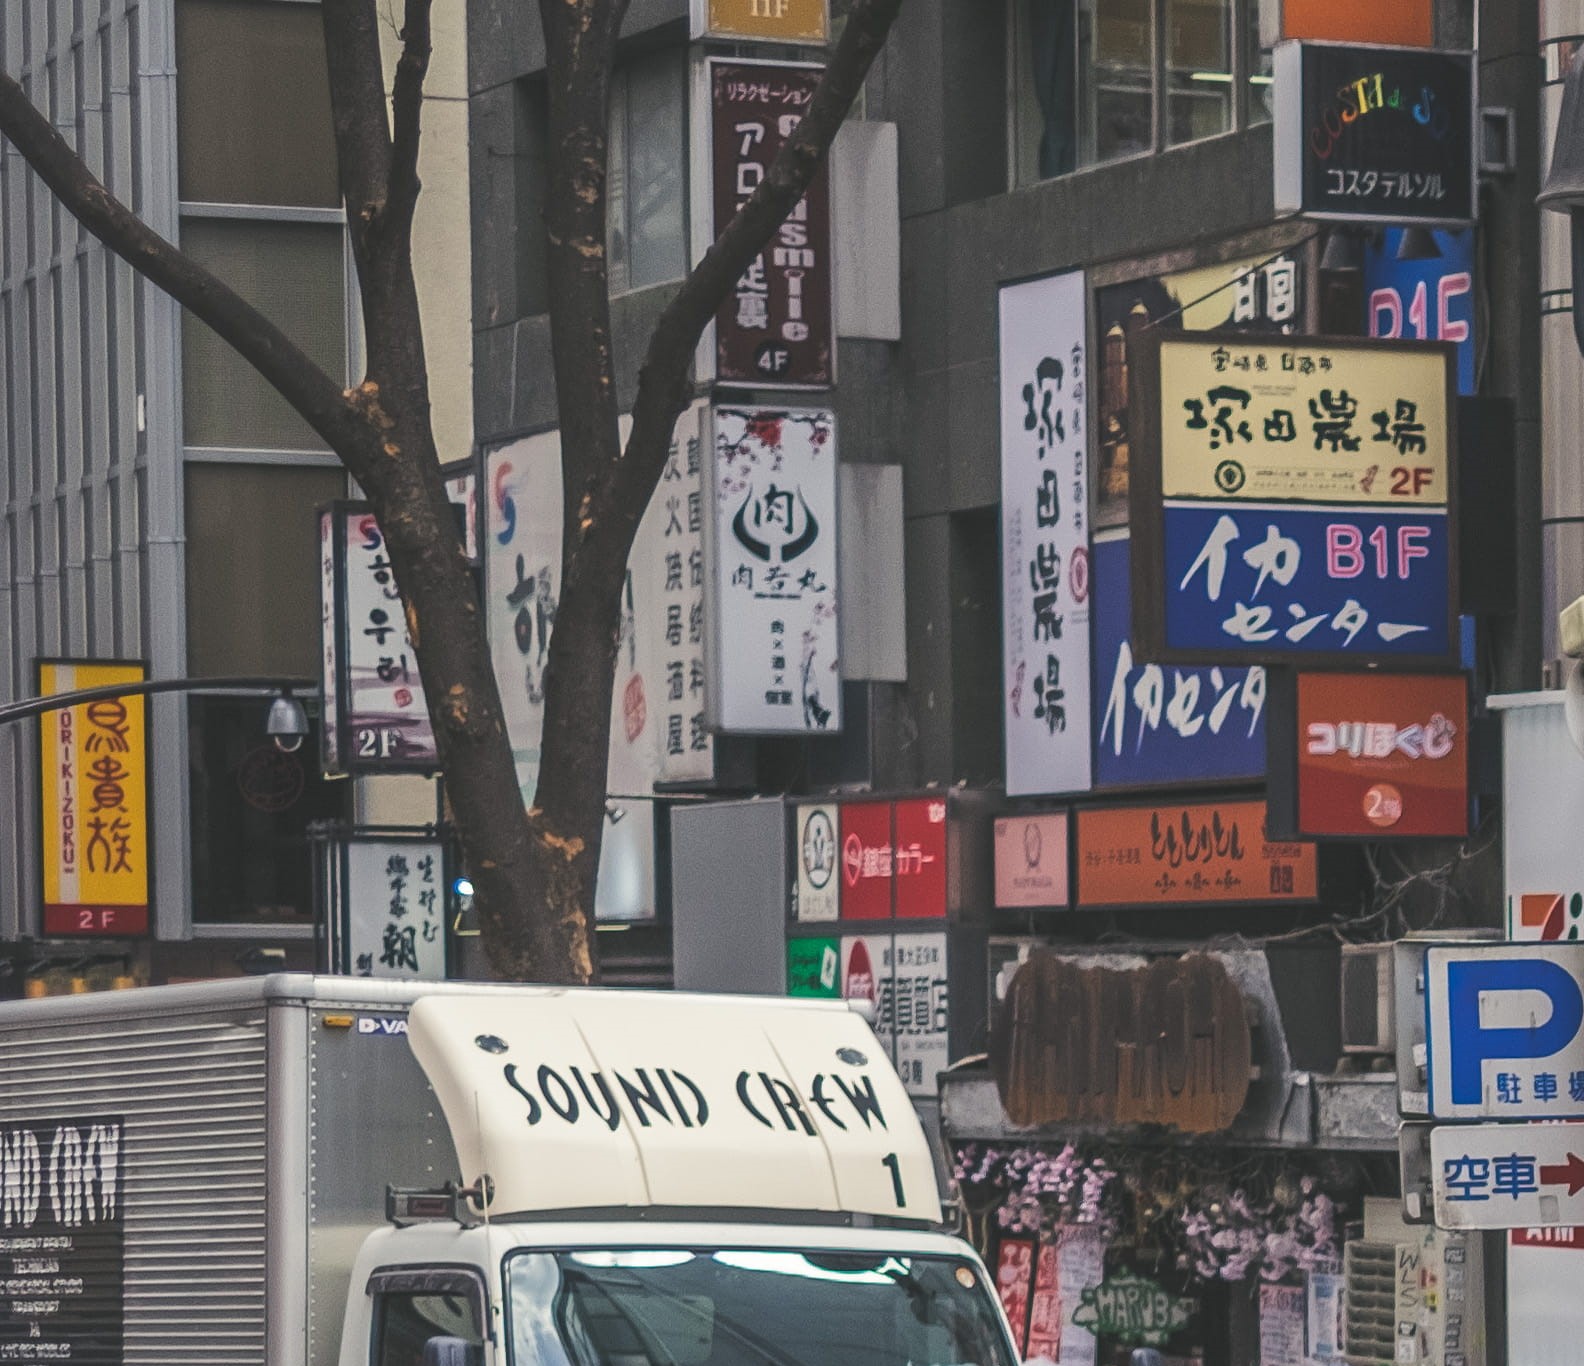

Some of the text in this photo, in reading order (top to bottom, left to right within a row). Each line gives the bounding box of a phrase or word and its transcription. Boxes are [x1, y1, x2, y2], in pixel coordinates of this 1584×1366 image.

[727, 82, 812, 104] リラクゼーション
[1327, 168, 1445, 199] コスタデルソル
[757, 349, 788, 371] 4F
[1182, 385, 1427, 455] 塚田農場
[1390, 467, 1434, 495] 2F
[1021, 355, 1067, 736] 塚田農場
[1180, 514, 1431, 601] イカ B1F
[1222, 599, 1430, 647] センター
[358, 729, 402, 757] 2F
[60, 706, 76, 866] ORIKIZOKU
[79, 910, 116, 929] 2F
[1447, 959, 1584, 1105] P
[503, 1063, 890, 1137] SOUND CREW
[882, 1151, 906, 1208] 1
[1443, 1154, 1540, 1201] 空車
